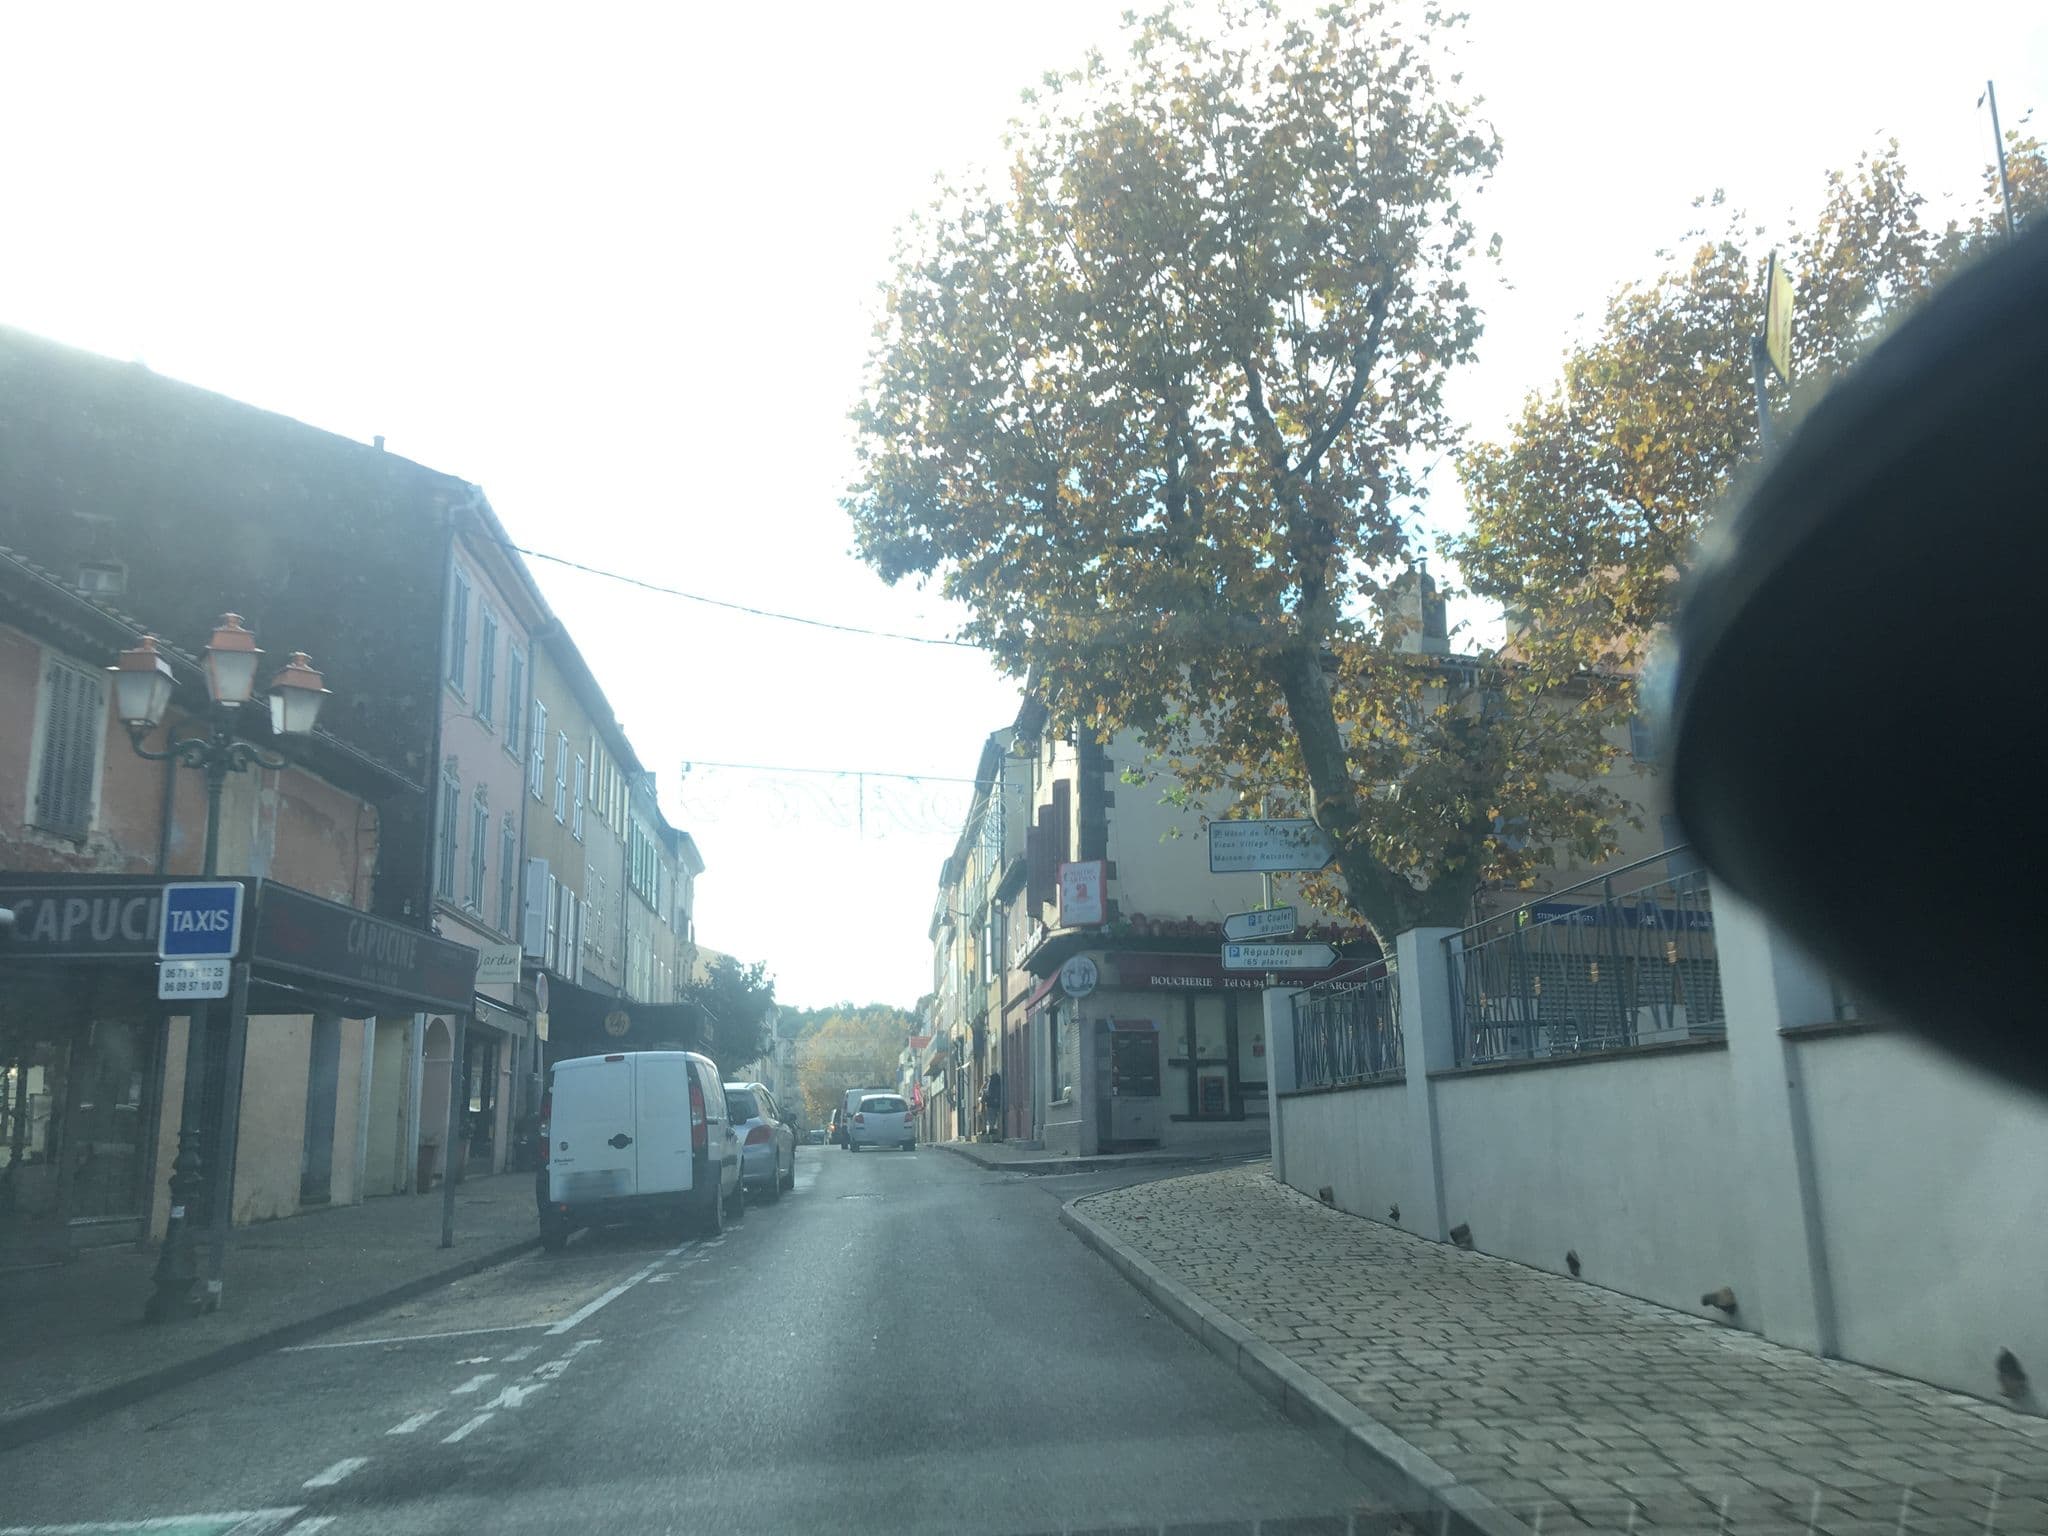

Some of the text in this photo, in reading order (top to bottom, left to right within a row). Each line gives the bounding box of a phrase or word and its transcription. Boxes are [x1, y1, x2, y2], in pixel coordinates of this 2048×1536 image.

[1240, 840, 1269, 849] Village
[171, 909, 230, 933] TAXIS
[346, 917, 418, 970] CAPUCINE
[1243, 947, 1303, 958] République
[1151, 975, 1213, 987] BOUCHERIE
[1240, 979, 1251, 988] 04
[1253, 979, 1265, 989] 94
